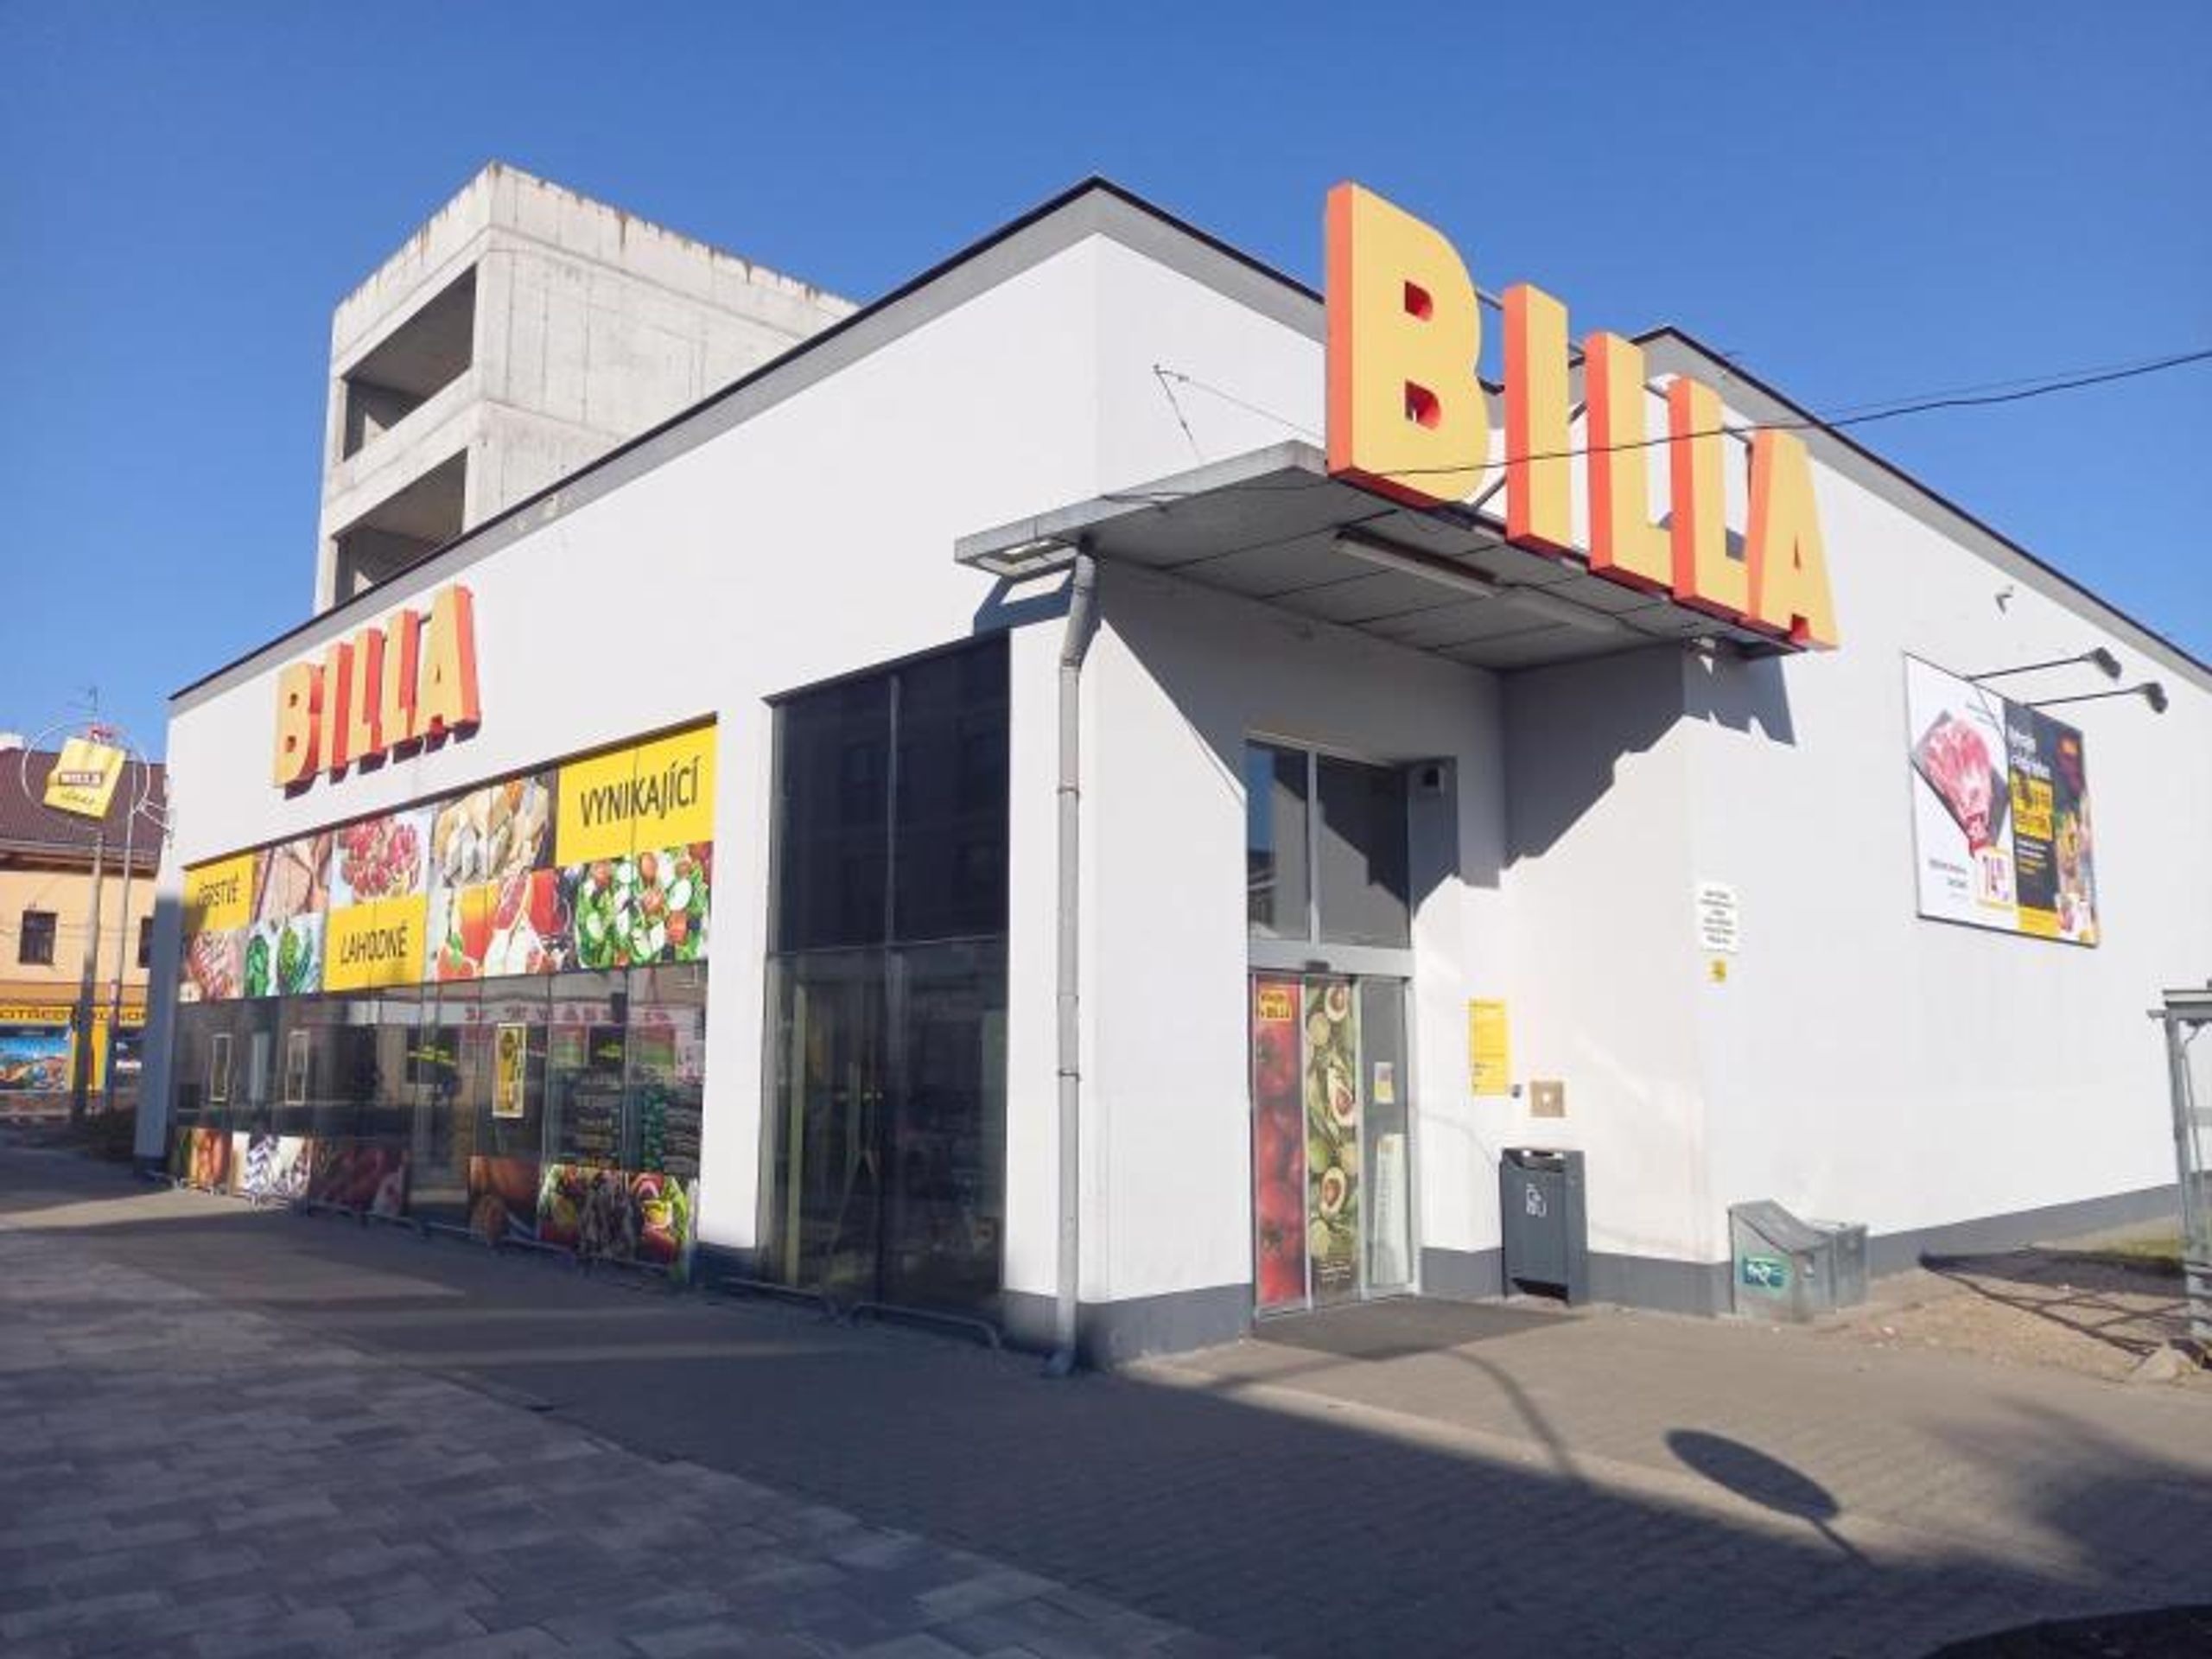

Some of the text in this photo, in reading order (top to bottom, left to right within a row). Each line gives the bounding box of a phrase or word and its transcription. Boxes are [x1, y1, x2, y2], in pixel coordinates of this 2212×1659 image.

[1326, 180, 1839, 652] BILLA
[273, 584, 481, 788] BILLA
[580, 754, 702, 828] VYNIKAJÍCÍ
[340, 918, 407, 965] LAHODNÉ
